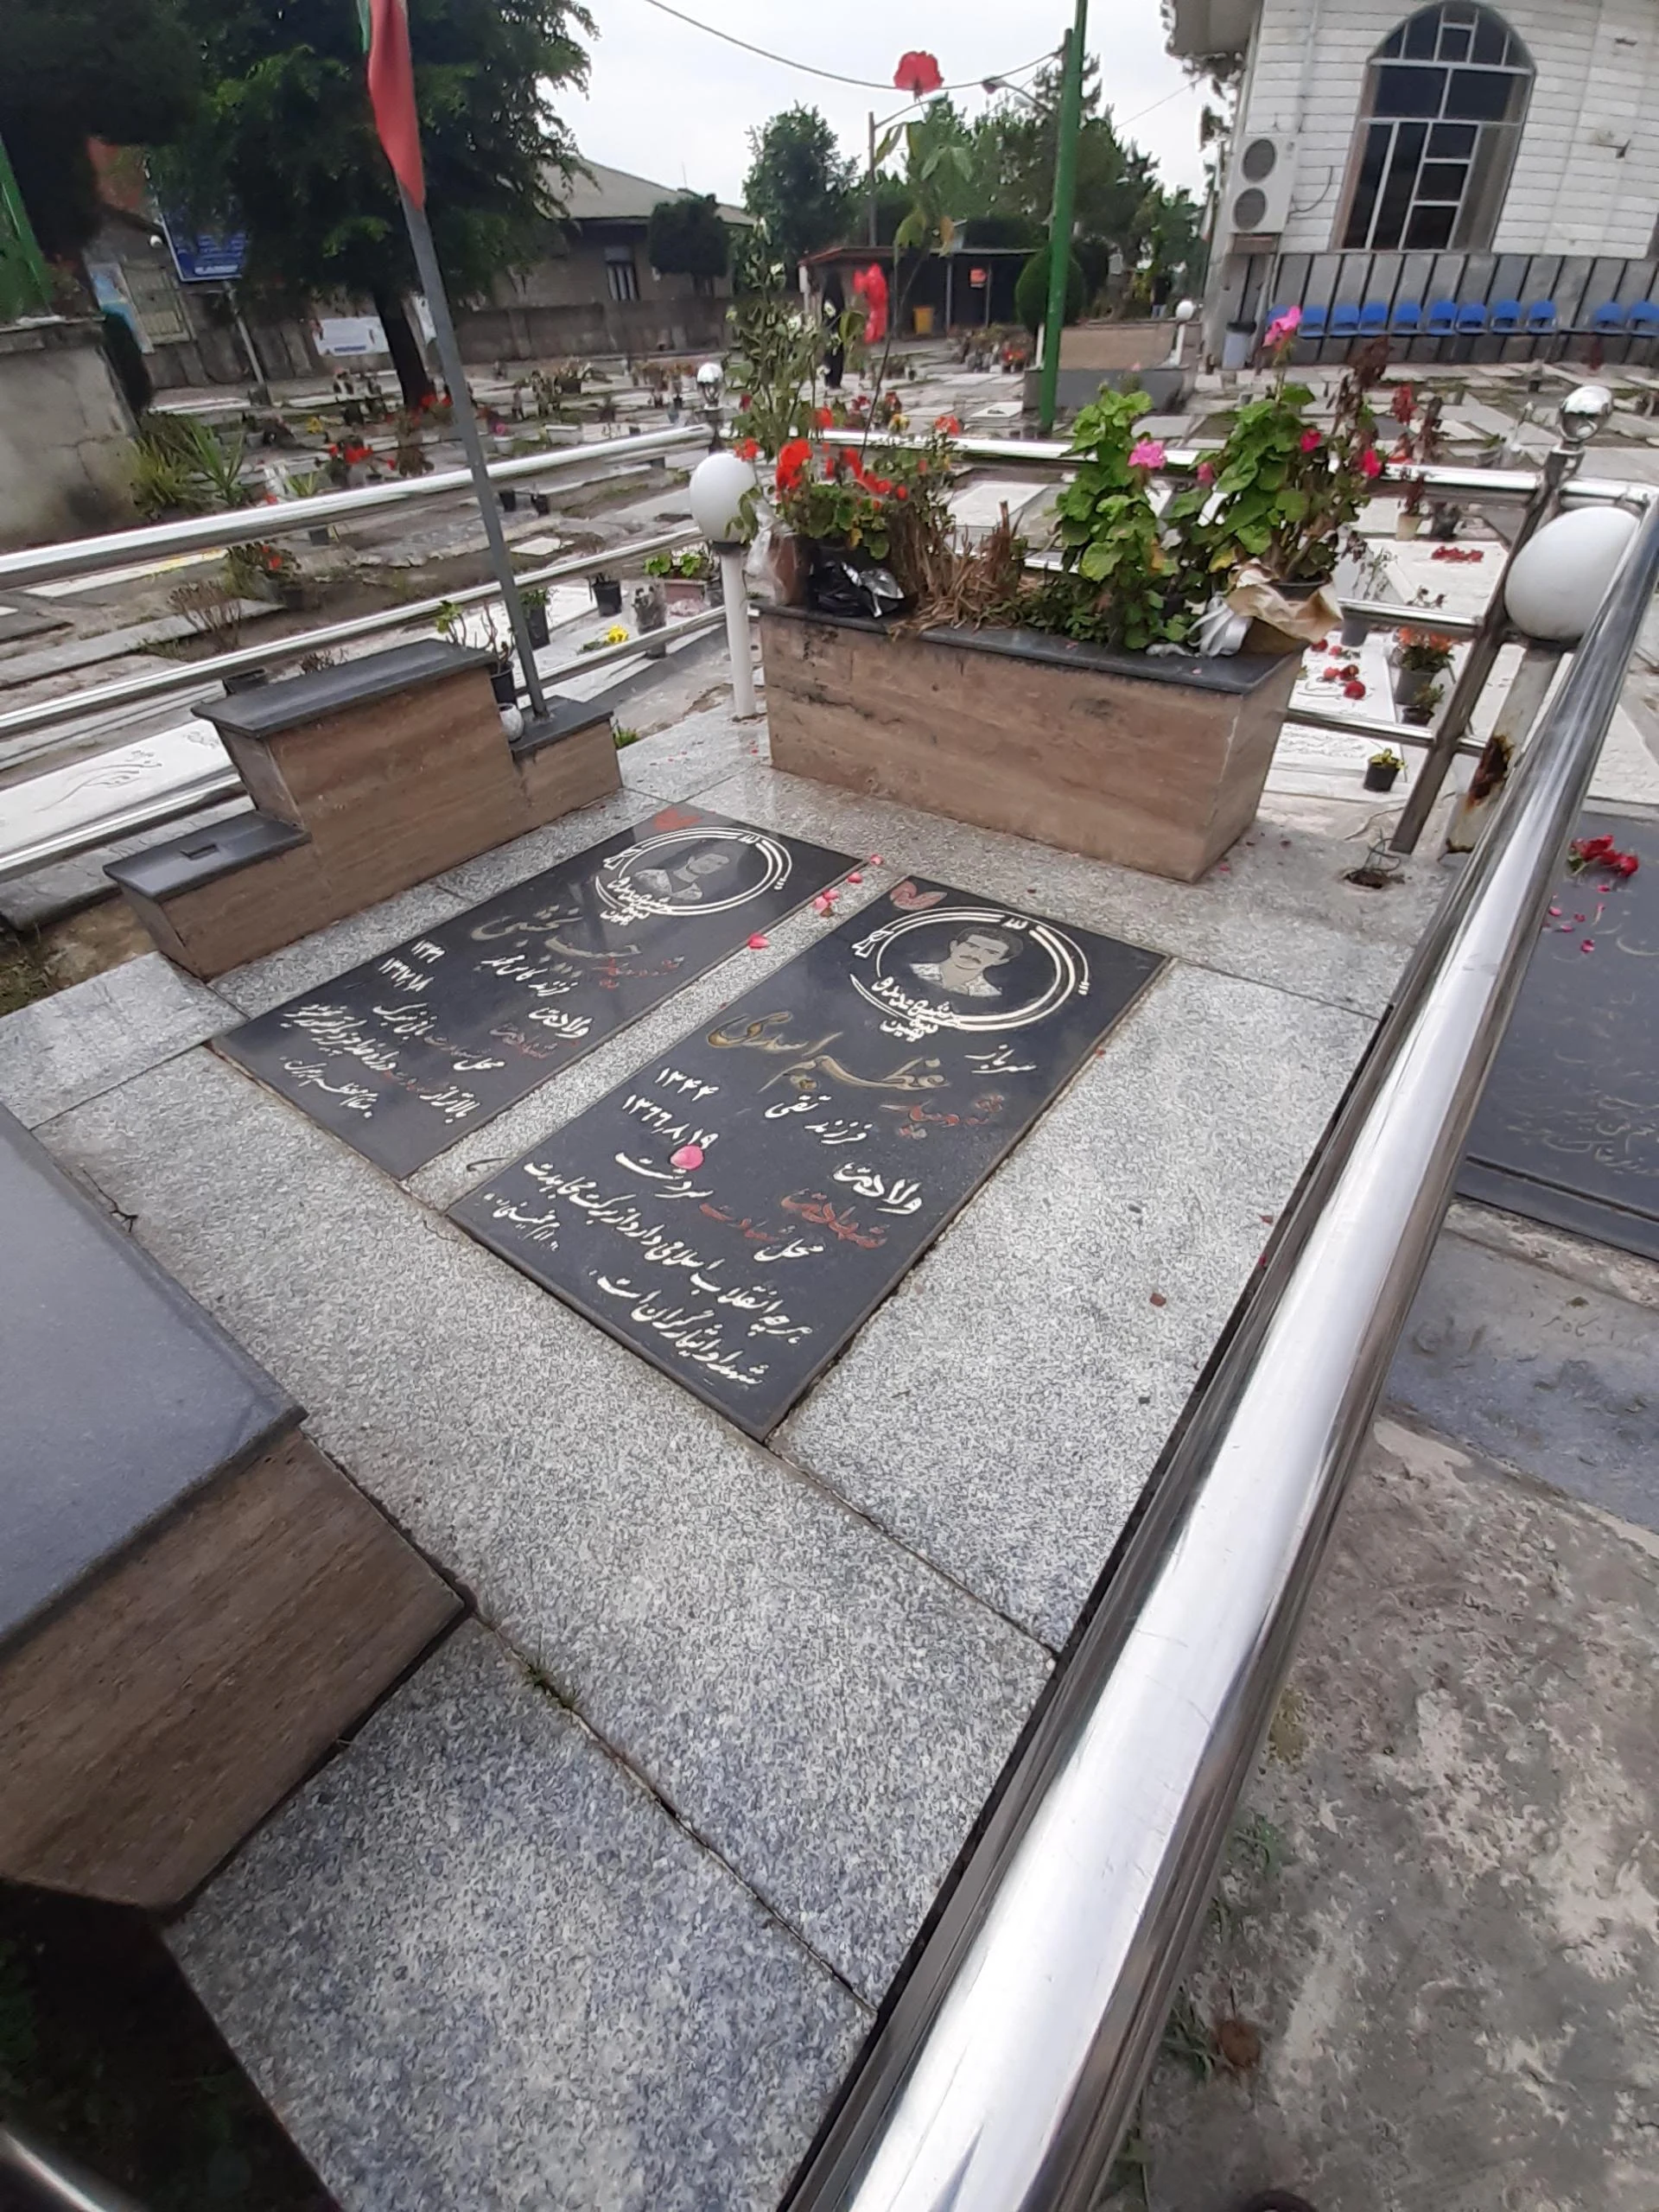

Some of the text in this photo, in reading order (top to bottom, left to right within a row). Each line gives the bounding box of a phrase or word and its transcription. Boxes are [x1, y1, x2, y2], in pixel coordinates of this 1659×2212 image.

[529, 1007, 592, 1038] ولادت
[706, 1012, 843, 1056] اسدی
[760, 1056, 950, 1092] عظیم
[765, 1094, 872, 1144] فرزند تقی
[834, 1162, 922, 1214] ولادت
[781, 1188, 890, 1249] شهادت
[645, 1242, 724, 1269] اسلامی
[754, 1239, 823, 1261] محل
[690, 1273, 783, 1313] انقلاب
